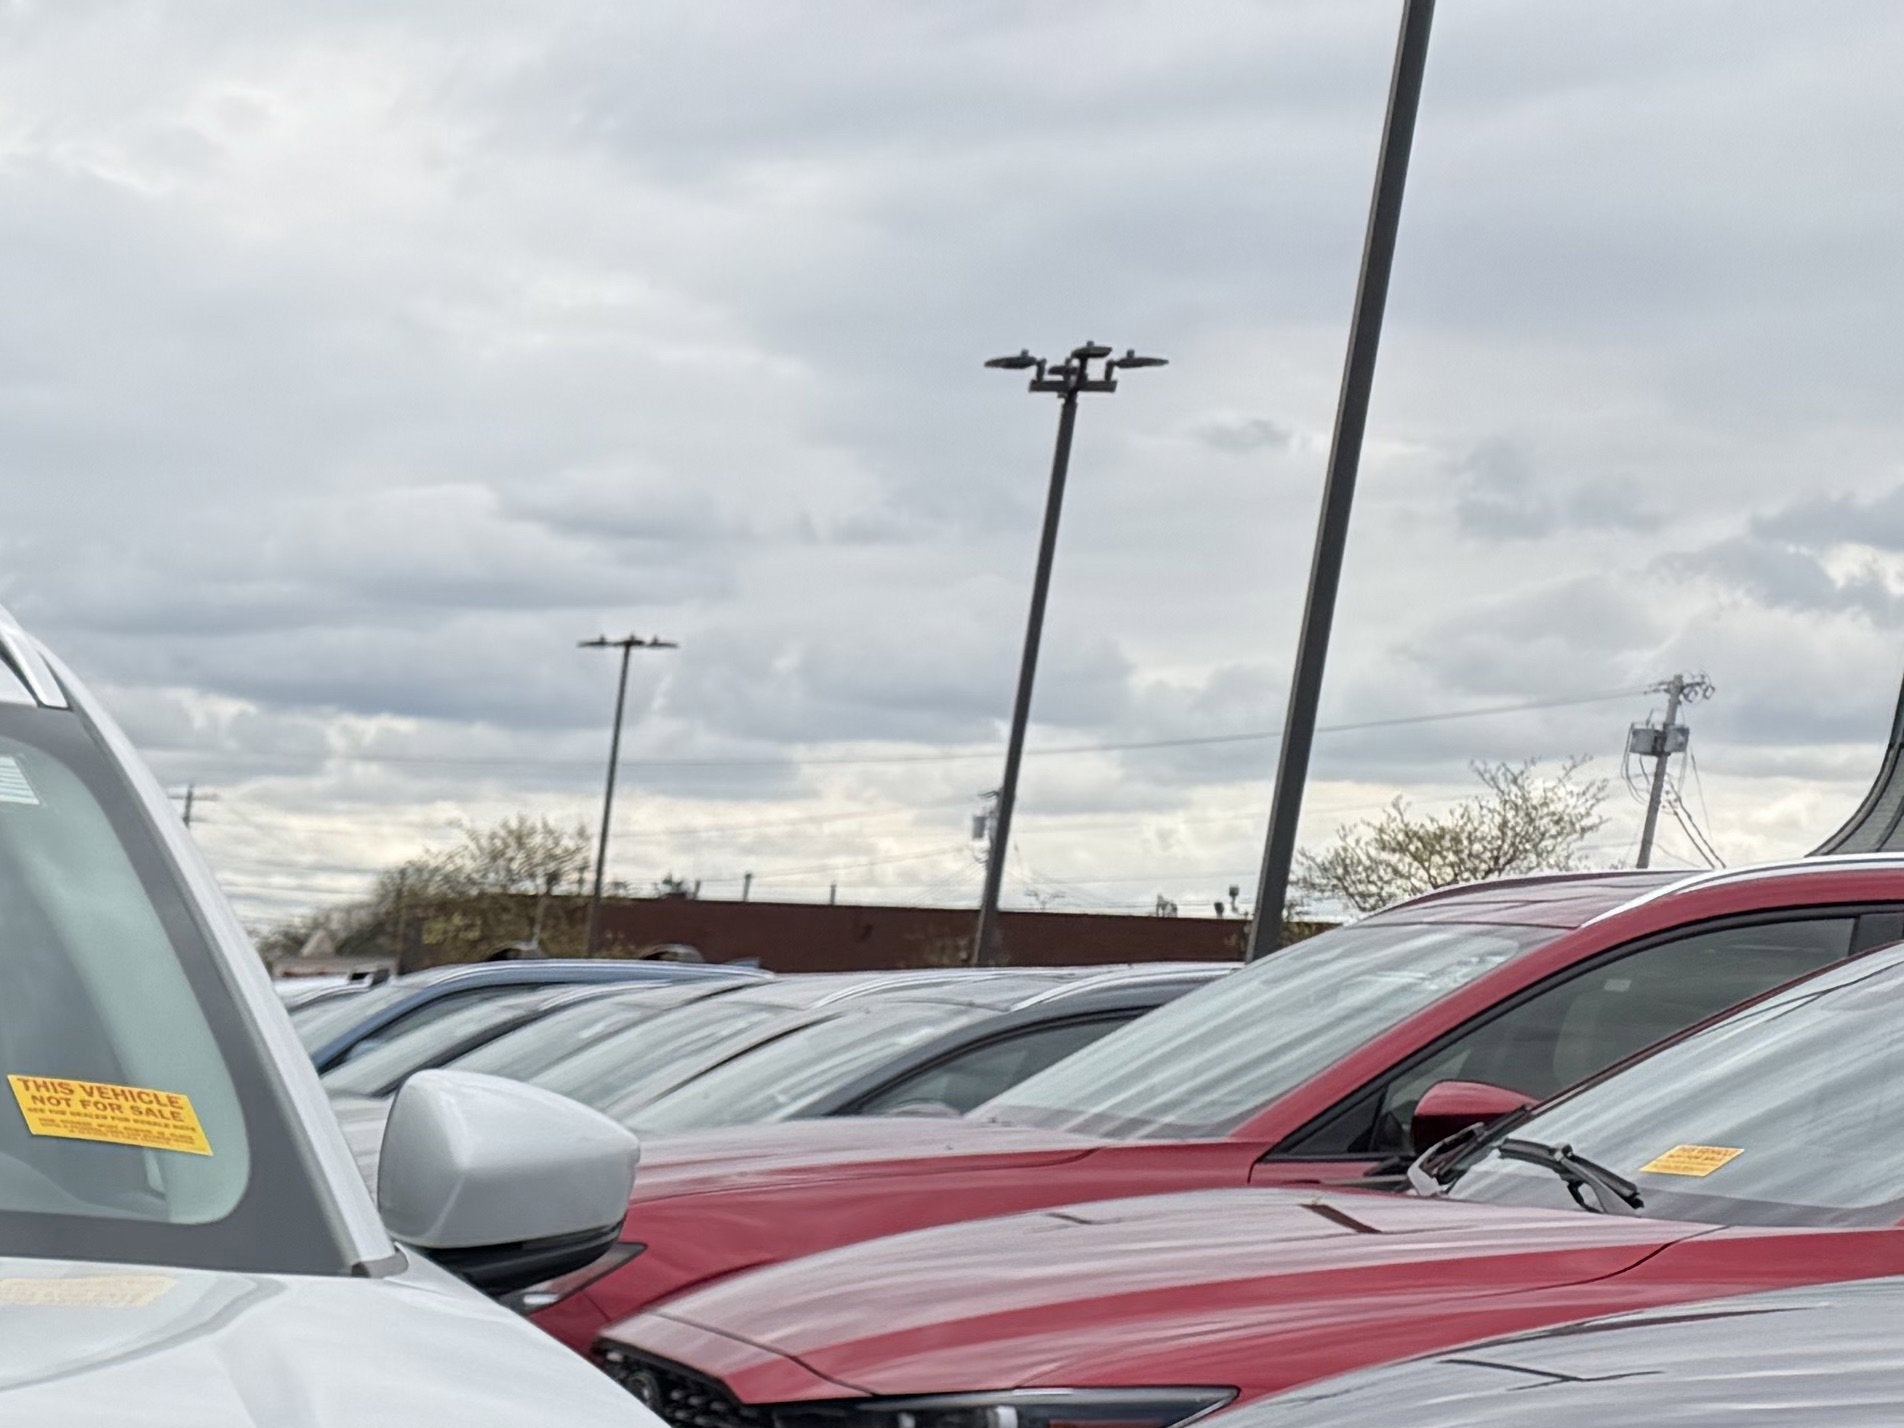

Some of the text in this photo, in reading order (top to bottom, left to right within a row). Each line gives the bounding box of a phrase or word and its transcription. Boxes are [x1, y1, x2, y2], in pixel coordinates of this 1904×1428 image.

[17, 1077, 184, 1110] THIS VEHICLE
[30, 1095, 72, 1108] NOT
[80, 1099, 124, 1114] FOR
[130, 1105, 185, 1122] SALE
